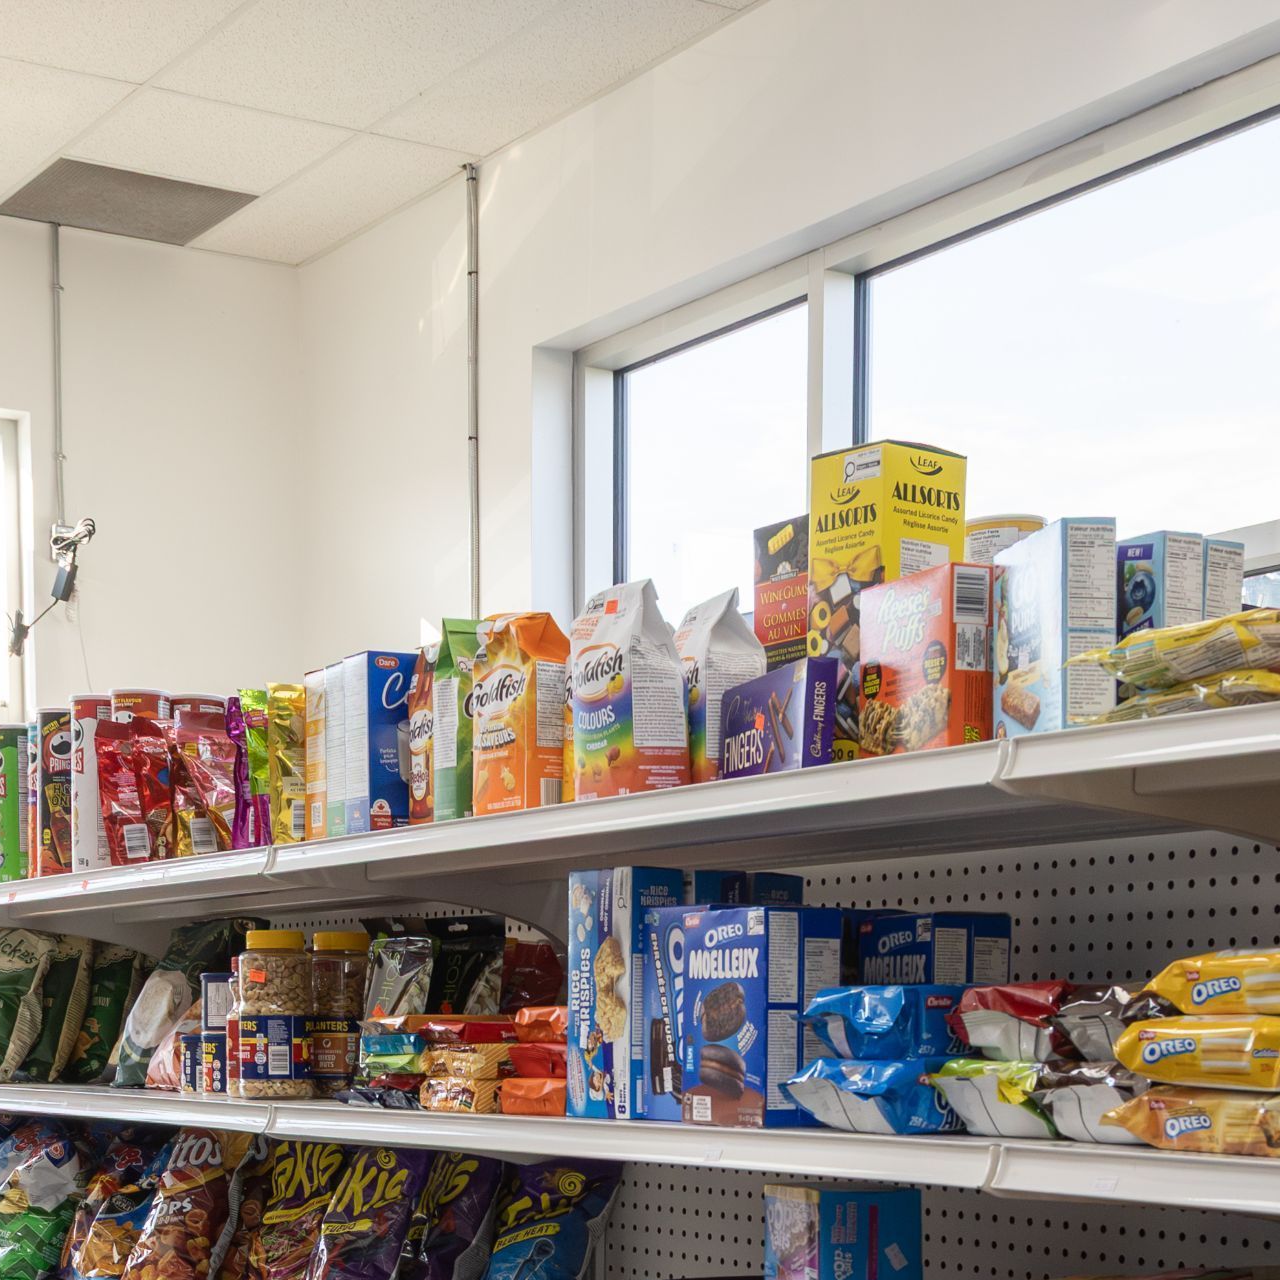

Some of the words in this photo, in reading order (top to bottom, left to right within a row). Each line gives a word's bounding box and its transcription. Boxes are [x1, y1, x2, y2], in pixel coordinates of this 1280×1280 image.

[917, 456, 938, 468] LEAF
[837, 486, 857, 498] LEAF
[892, 481, 961, 511] ALLSORTS
[815, 503, 877, 534] ALLSORTS
[893, 506, 917, 517] Assorted
[919, 510, 940, 522] Licorice
[941, 515, 958, 525] Candy
[816, 537, 837, 548] Assorted
[837, 532, 858, 542] Licorice
[859, 529, 875, 538] Candy
[928, 524, 949, 534] Assortie
[1127, 547, 1143, 557] NEW!
[764, 608, 807, 629] GOMMES
[768, 629, 781, 640] AU
[784, 623, 801, 638] VIN
[882, 618, 927, 654] Puffs
[377, 658, 396, 667] Dare
[473, 670, 527, 709] Goldfish
[813, 681, 827, 726] FINGERS
[578, 705, 616, 730] COLOURS
[724, 729, 764, 775] FINGERS
[704, 923, 744, 948] OREO
[878, 930, 913, 954] OREO
[689, 947, 759, 979] MOELLEUX
[864, 954, 926, 984] MOELLEUX
[570, 969, 581, 1012] RICE
[1190, 976, 1243, 1006] OREO
[1141, 1036, 1198, 1064] OREO
[1163, 1113, 1212, 1138] OREO
[496, 1234, 522, 1250] BLUE
[524, 1224, 554, 1239] HEAT
